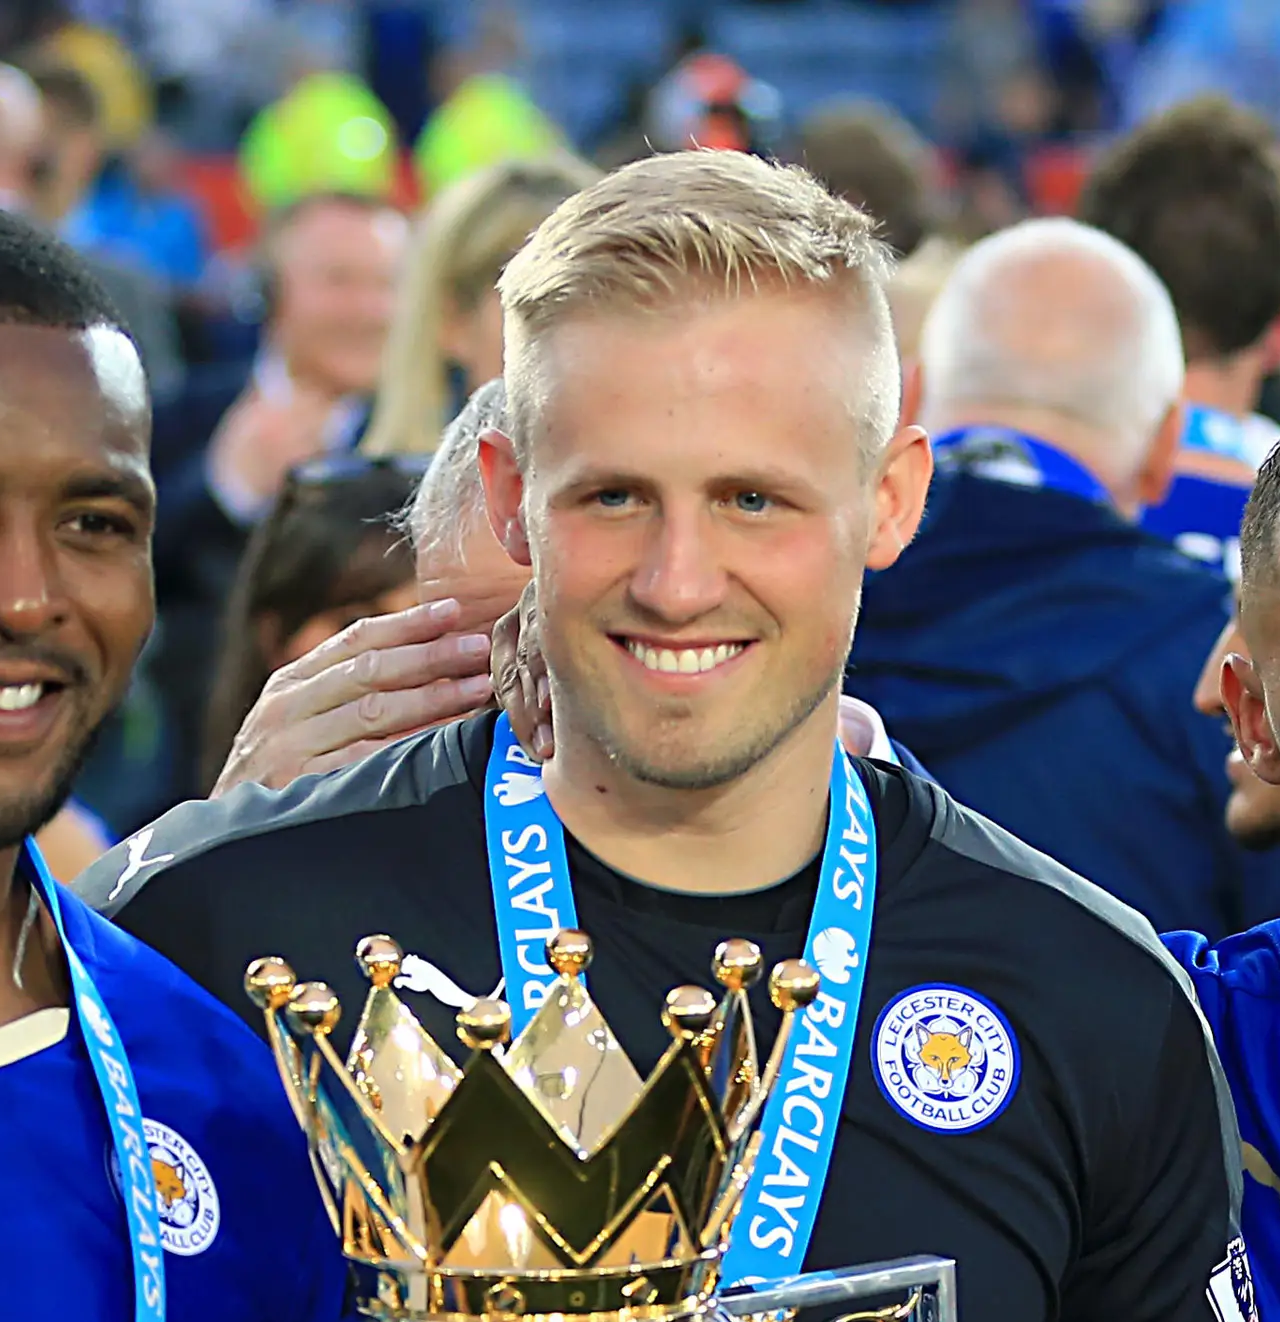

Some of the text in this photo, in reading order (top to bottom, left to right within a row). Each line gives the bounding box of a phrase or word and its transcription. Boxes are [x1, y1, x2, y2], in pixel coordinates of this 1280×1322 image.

[832, 750, 869, 911] LAYS
[501, 824, 562, 1010] RCLAYS
[885, 996, 1006, 1056] LEICESTER CITY
[748, 986, 847, 1257] BARCLAYS
[885, 1060, 1006, 1121] FOOTBALL CLUB
[99, 1049, 163, 1318] BARCLAYS
[186, 1154, 213, 1200] CITY
[190, 1207, 215, 1247] CLUB
